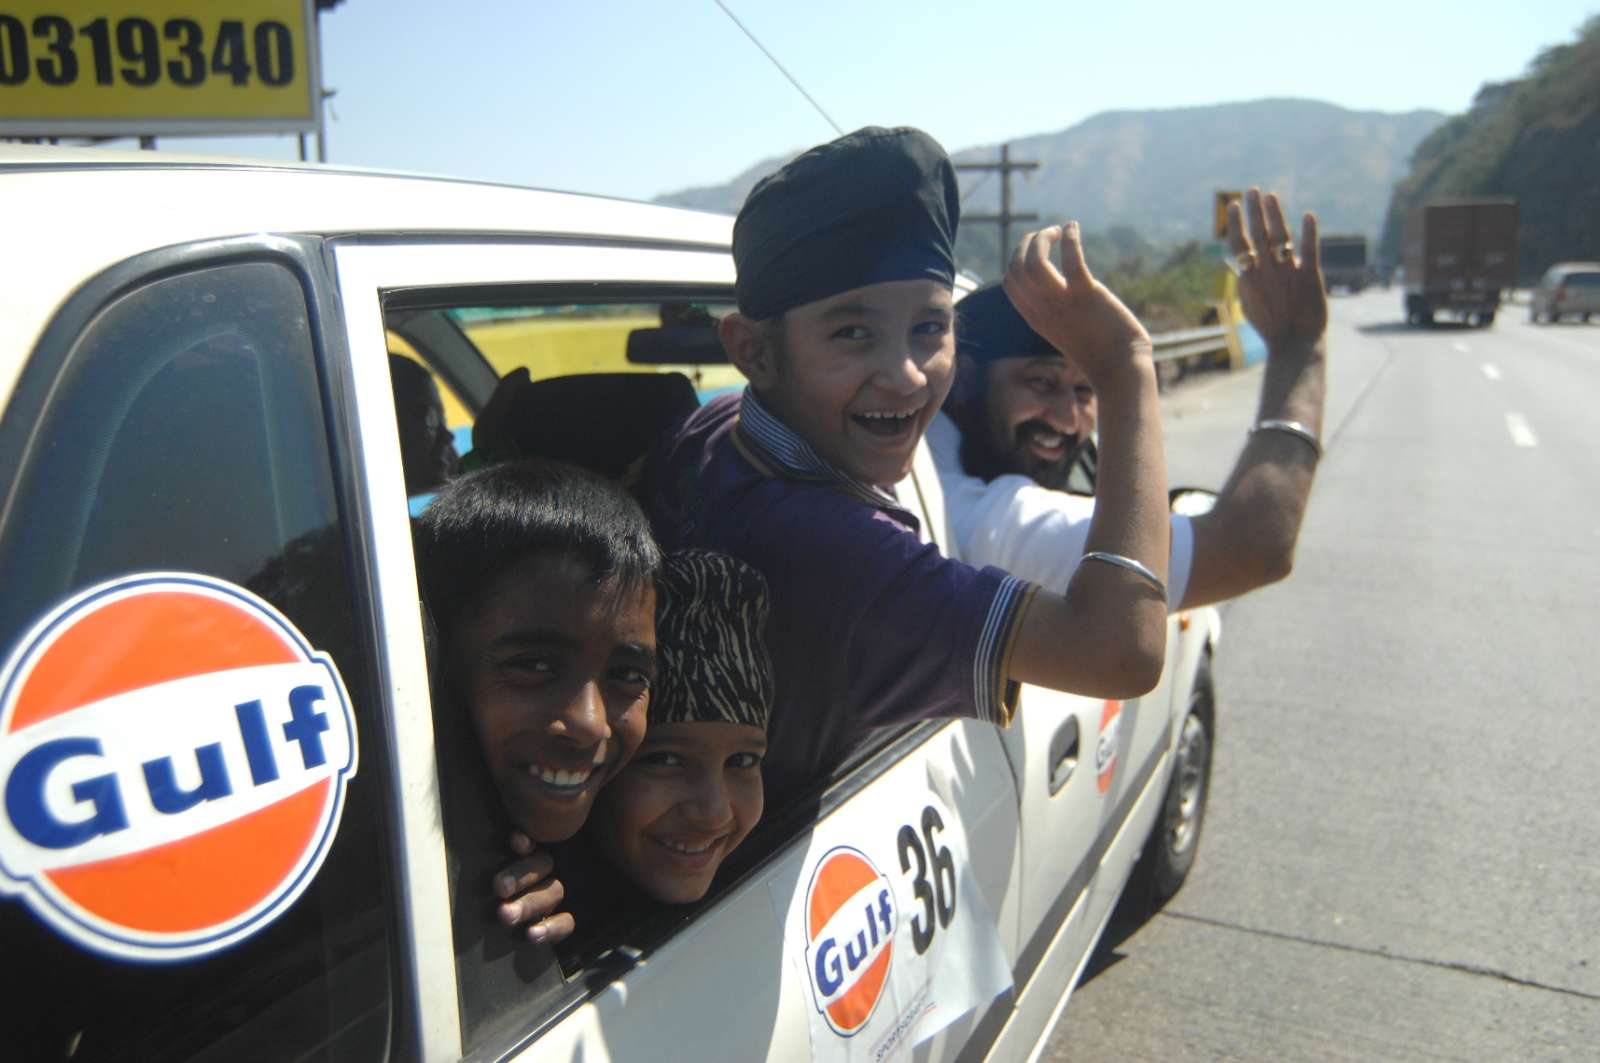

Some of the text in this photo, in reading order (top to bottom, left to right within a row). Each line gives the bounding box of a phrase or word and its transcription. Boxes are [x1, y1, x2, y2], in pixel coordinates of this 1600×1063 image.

[4, 684, 331, 850] Gulf
[814, 889, 892, 998] Gulf
[897, 805, 956, 956] 36
